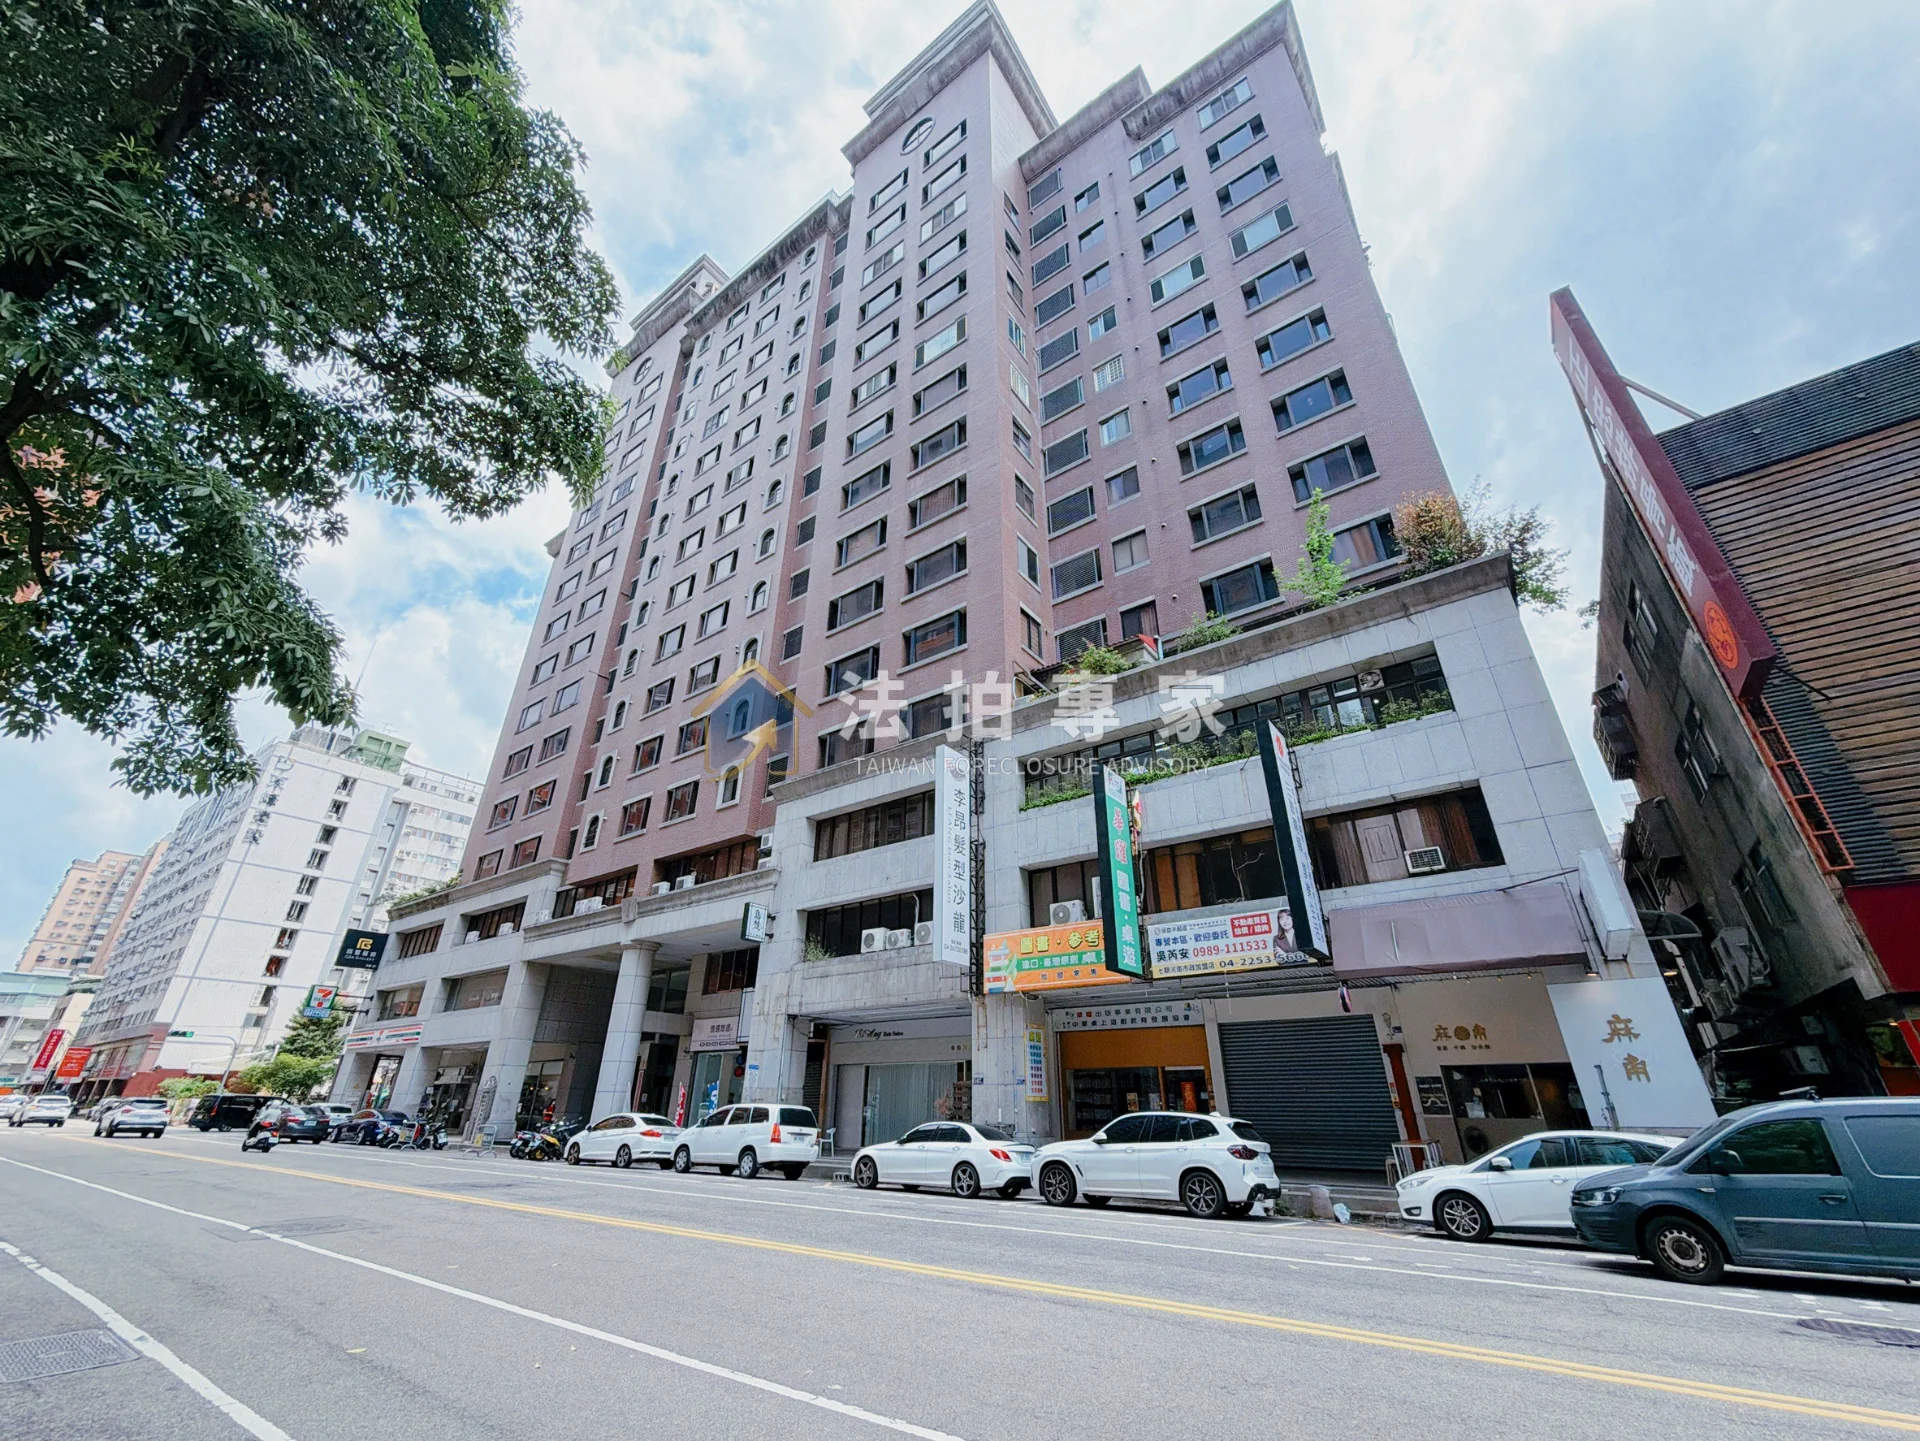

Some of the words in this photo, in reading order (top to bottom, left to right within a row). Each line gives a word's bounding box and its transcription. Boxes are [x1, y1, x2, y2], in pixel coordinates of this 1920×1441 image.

[1567, 337, 1697, 597] 正忠排骨飯
[953, 788, 967, 934] 李昂髮型沙龍
[1020, 928, 1105, 954] 圖書·參考
[1154, 929, 1230, 948] 專營本區·歡迎委託
[1156, 948, 1190, 963] 吳芮安
[1192, 939, 1268, 958] 0989-111533
